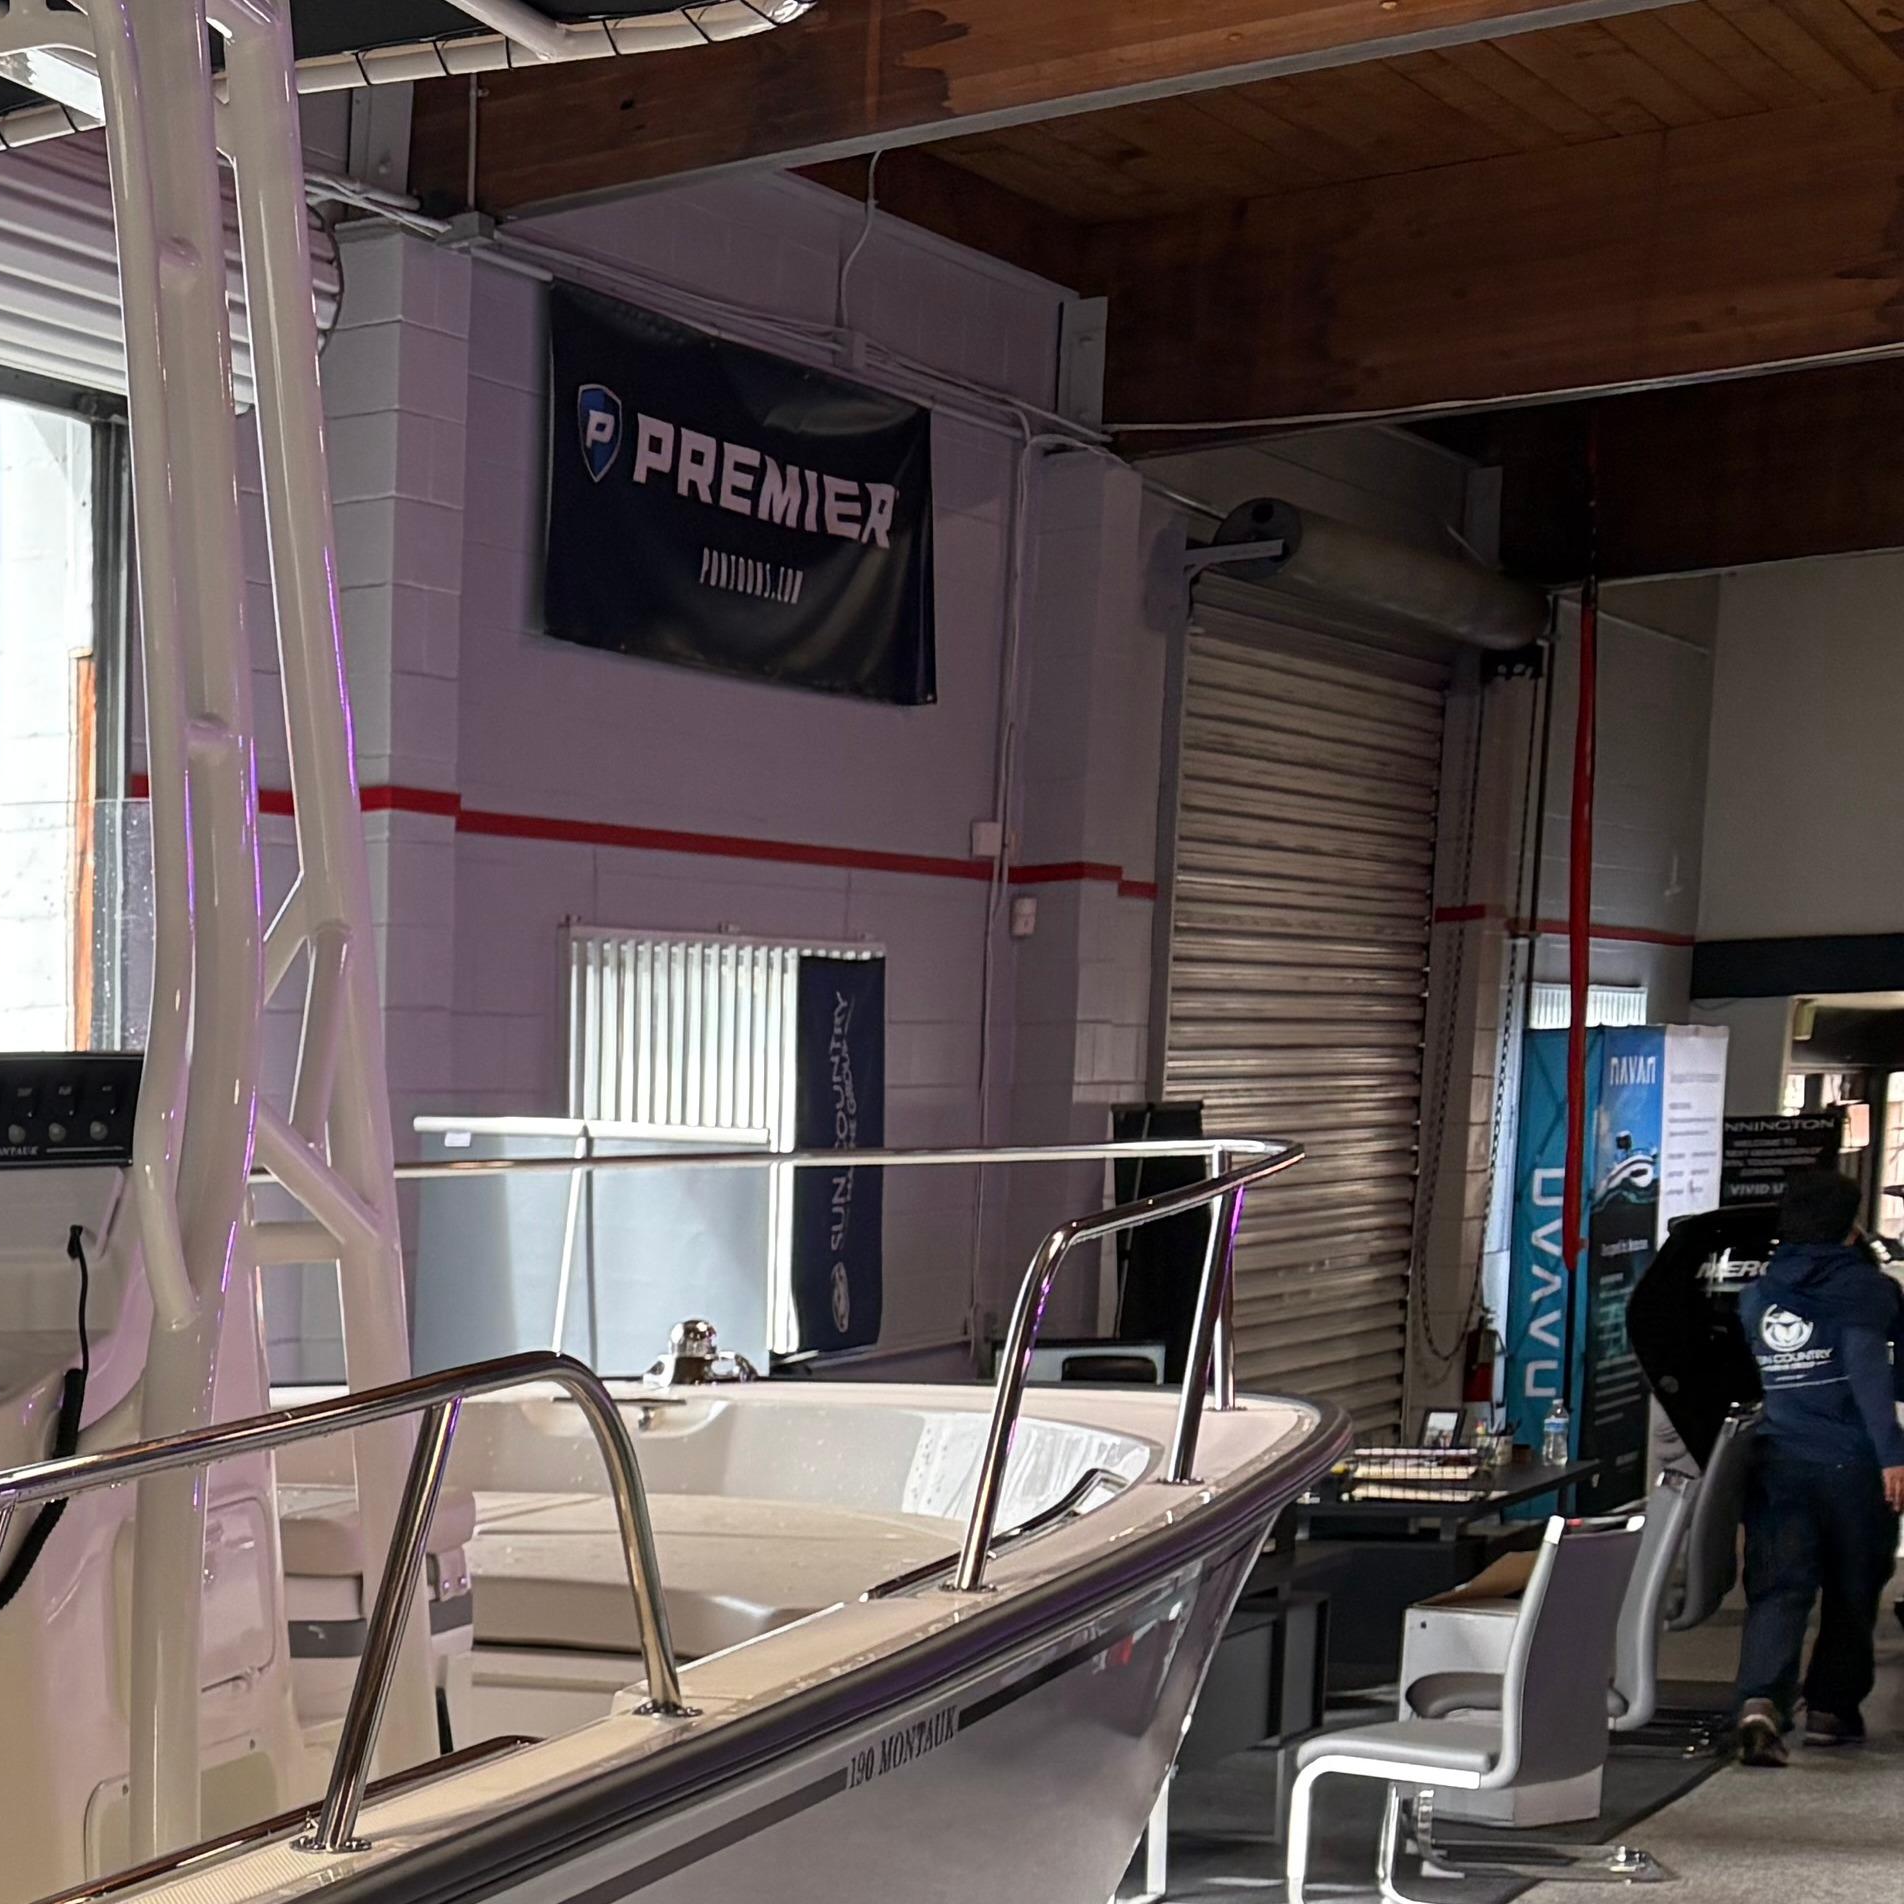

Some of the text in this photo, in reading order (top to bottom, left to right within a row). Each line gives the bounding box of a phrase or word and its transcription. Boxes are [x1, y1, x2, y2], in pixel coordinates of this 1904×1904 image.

[633, 413, 899, 548] PREMIER
[1610, 1056, 1656, 1085] NAVAN
[829, 991, 848, 1251] SUN OUNTRY
[1725, 1118, 1835, 1133] NNINGTON
[849, 1705, 957, 1789] 190 MONTAUK
